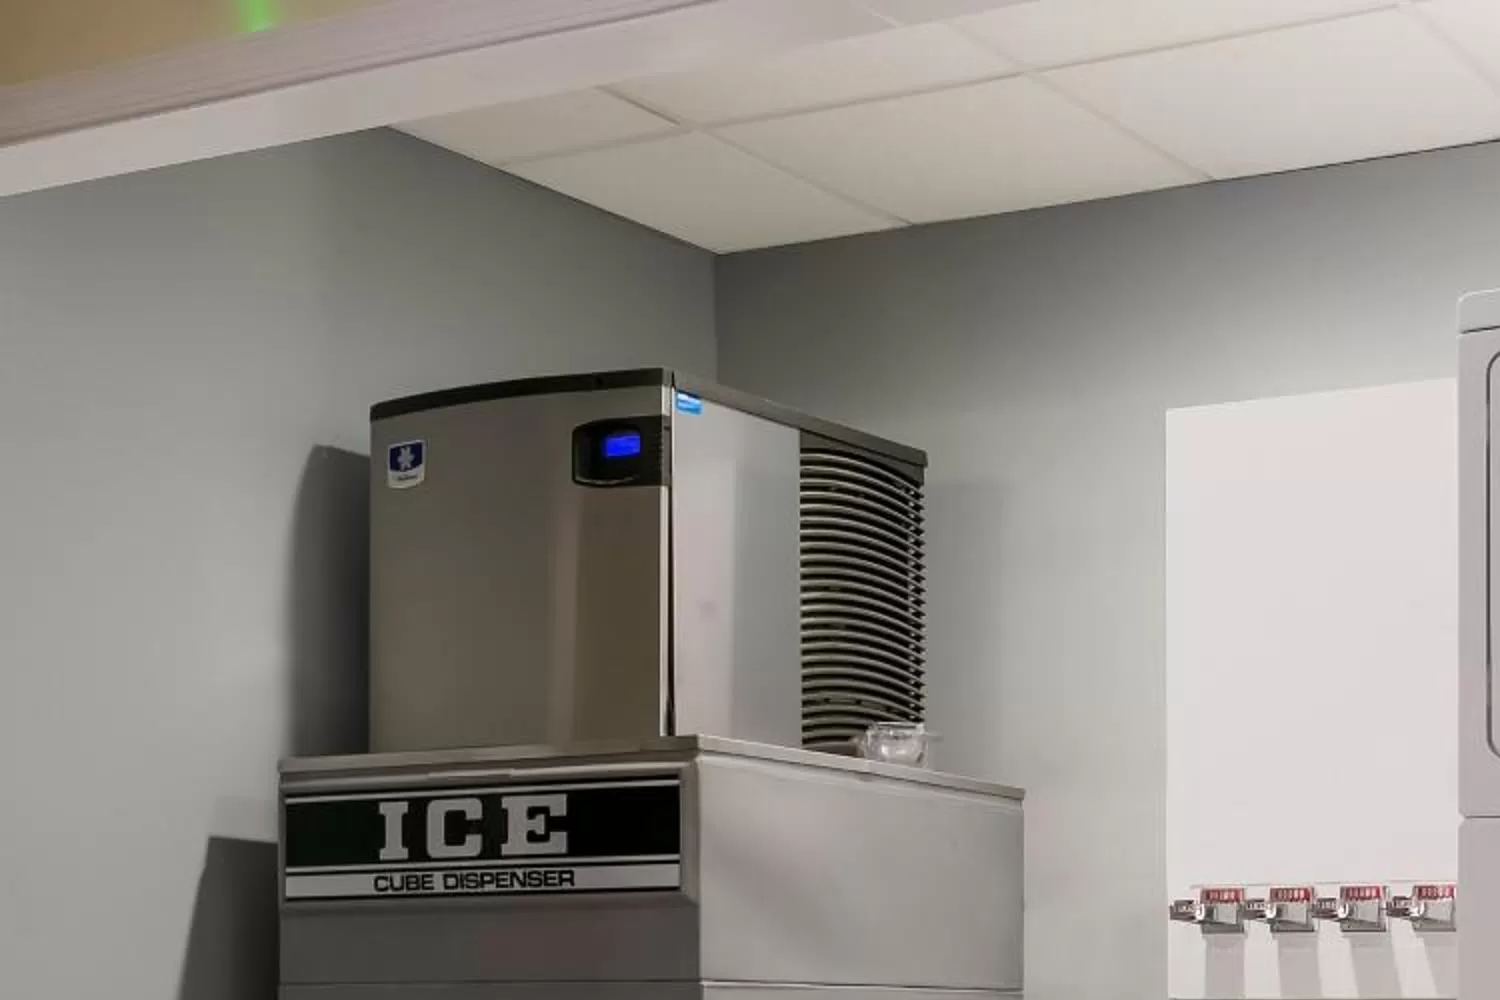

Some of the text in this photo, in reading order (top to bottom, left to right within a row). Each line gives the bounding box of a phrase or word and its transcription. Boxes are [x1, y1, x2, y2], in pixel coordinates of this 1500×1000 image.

[379, 794, 568, 861] ICE
[374, 869, 575, 892] CUBE DISPENSER
